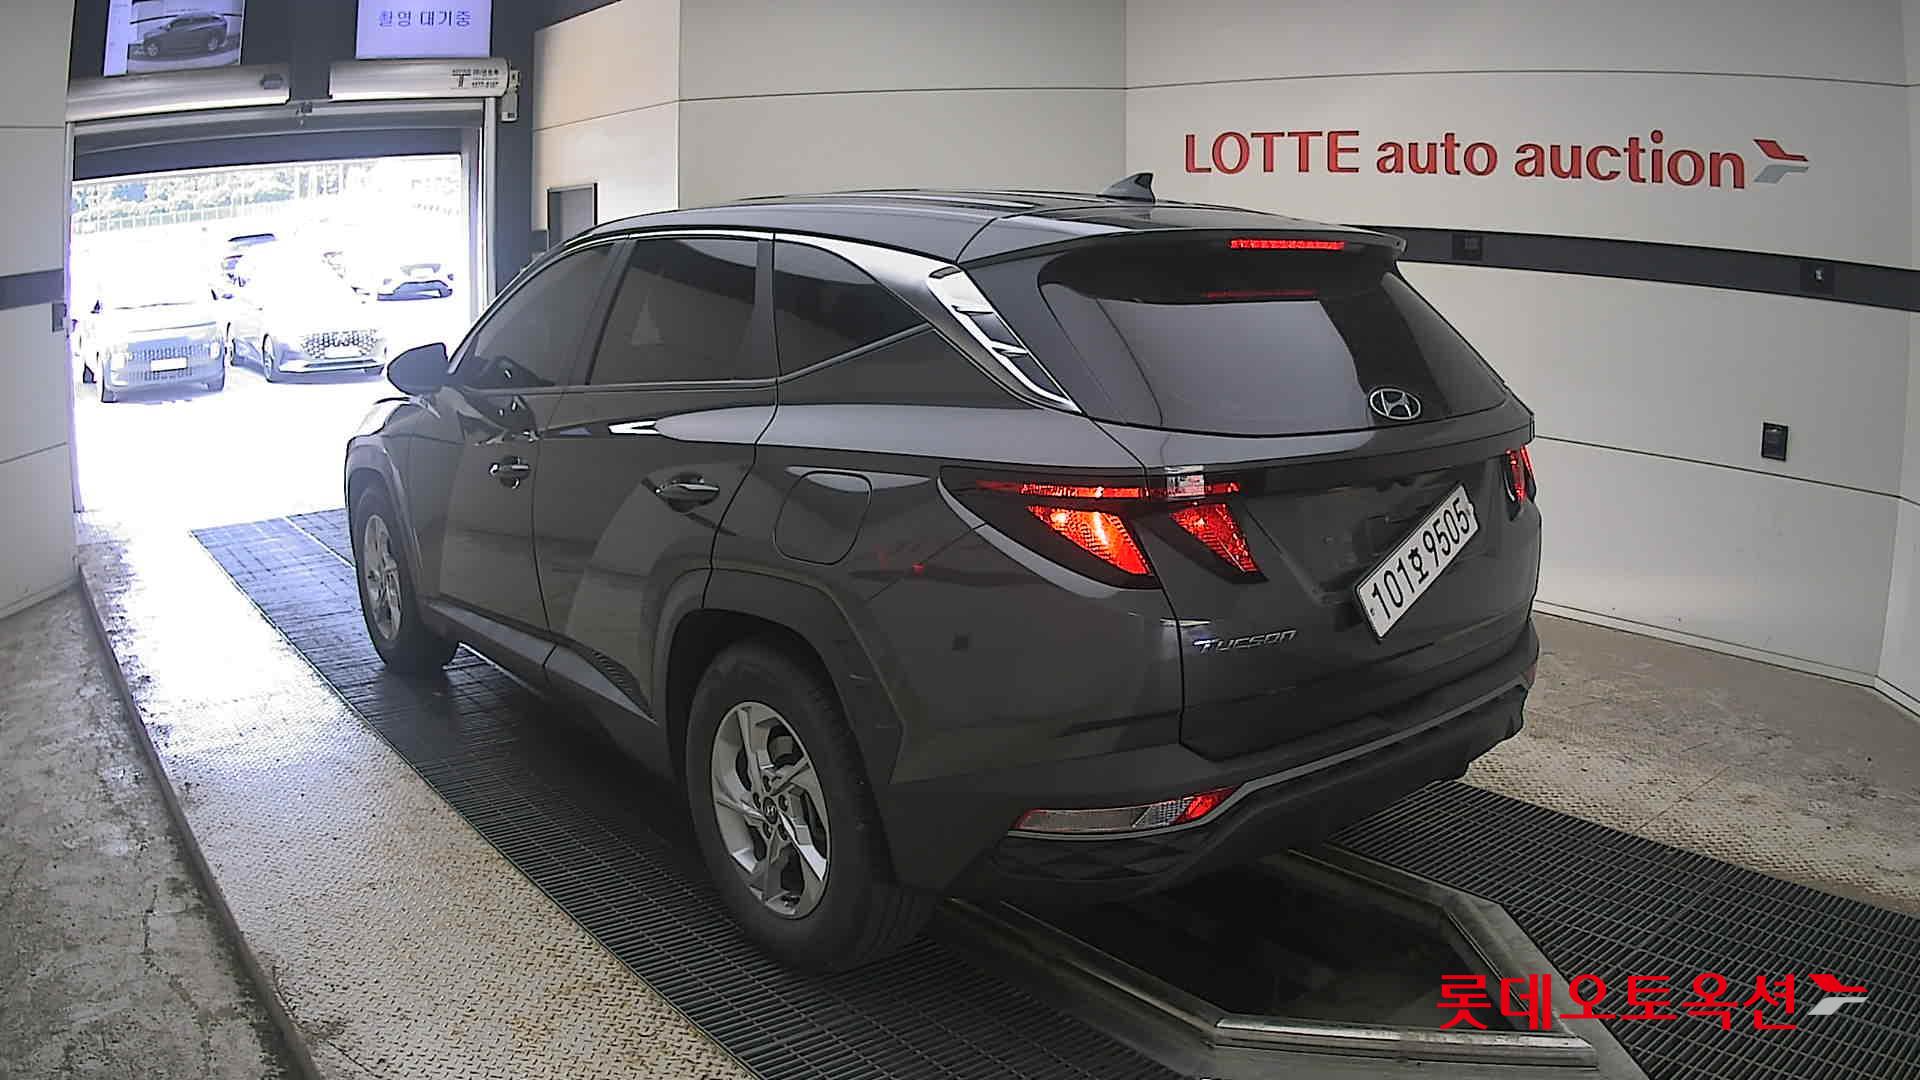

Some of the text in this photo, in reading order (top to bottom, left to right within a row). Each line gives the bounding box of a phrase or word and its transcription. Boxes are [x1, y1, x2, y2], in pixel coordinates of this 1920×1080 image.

[420, 11, 472, 27] 대기중
[1184, 130, 1745, 188] LOTTE auto auction
